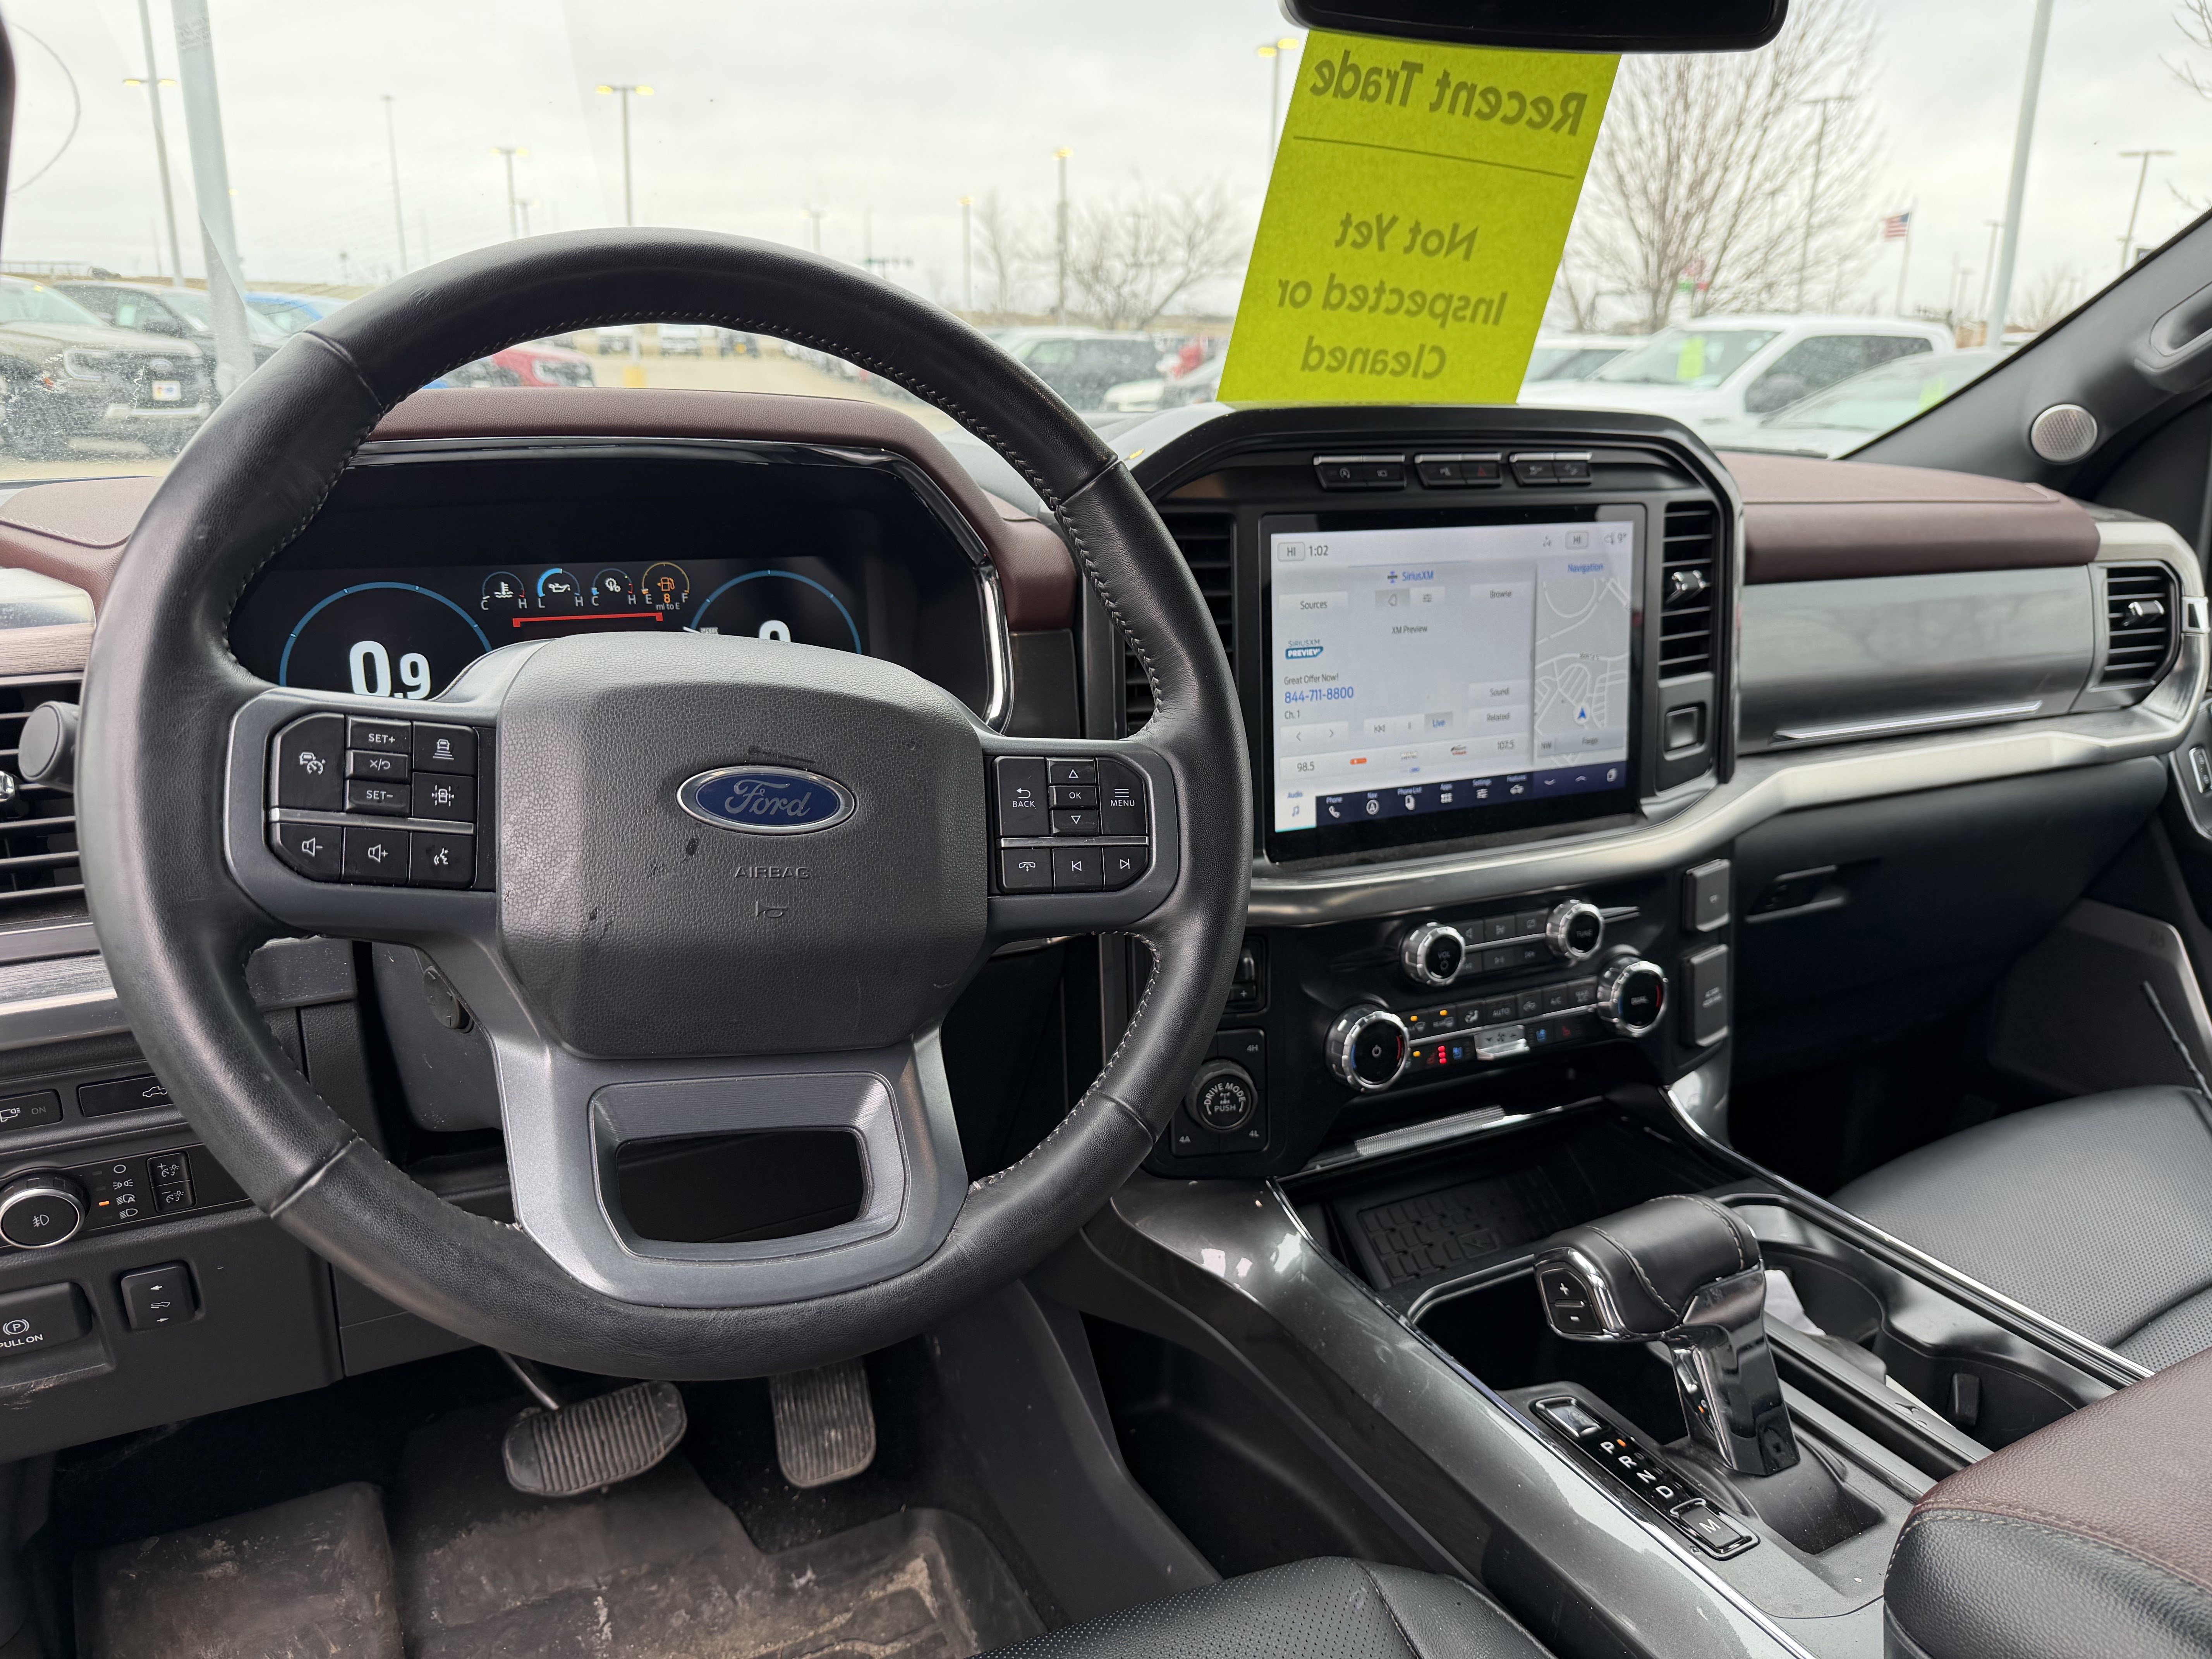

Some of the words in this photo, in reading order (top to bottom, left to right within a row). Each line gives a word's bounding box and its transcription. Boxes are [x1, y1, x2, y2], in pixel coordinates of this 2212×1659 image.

[1287, 547, 1296, 556] HI
[1309, 545, 1329, 556] 1:02
[1402, 570, 1434, 581] SiriusXM
[519, 598, 527, 608] H
[539, 597, 545, 608] L
[575, 596, 584, 606] H
[591, 596, 599, 606] C
[628, 594, 636, 605] H
[646, 592, 652, 604] E
[664, 593, 671, 603] 8
[682, 592, 688, 603] F
[481, 599, 489, 610] C
[1300, 601, 1328, 610] Sources
[1403, 625, 1428, 634] Preview
[1288, 639, 1320, 647] SIRIUSXM
[1287, 649, 1318, 658] PREVIEW
[350, 641, 431, 699] 0.9
[1284, 676, 1303, 685] Great
[1304, 674, 1320, 684] Offer
[1321, 673, 1339, 682] Now!
[1285, 686, 1354, 704] 844-711-8800
[1284, 711, 1295, 720] Ch.
[1297, 710, 1300, 719] 1
[368, 733, 395, 743] SET+
[1297, 761, 1315, 772] 98.5
[725, 779, 812, 817] Ford
[1288, 791, 1304, 799] Audio
[735, 867, 810, 878] AIRBAG
[1492, 1007, 1510, 1017] AUTO
[1204, 1083, 1224, 1105] DRIVE
[1225, 1082, 1246, 1102] MODE
[1179, 1135, 1190, 1144] 4A
[26, 1334, 43, 1343] ON
[1600, 1441, 1615, 1455] P
[1618, 1456, 1637, 1469] R
[1637, 1470, 1657, 1484] N
[1655, 1486, 1674, 1499] D
[1699, 1518, 1721, 1533] M
